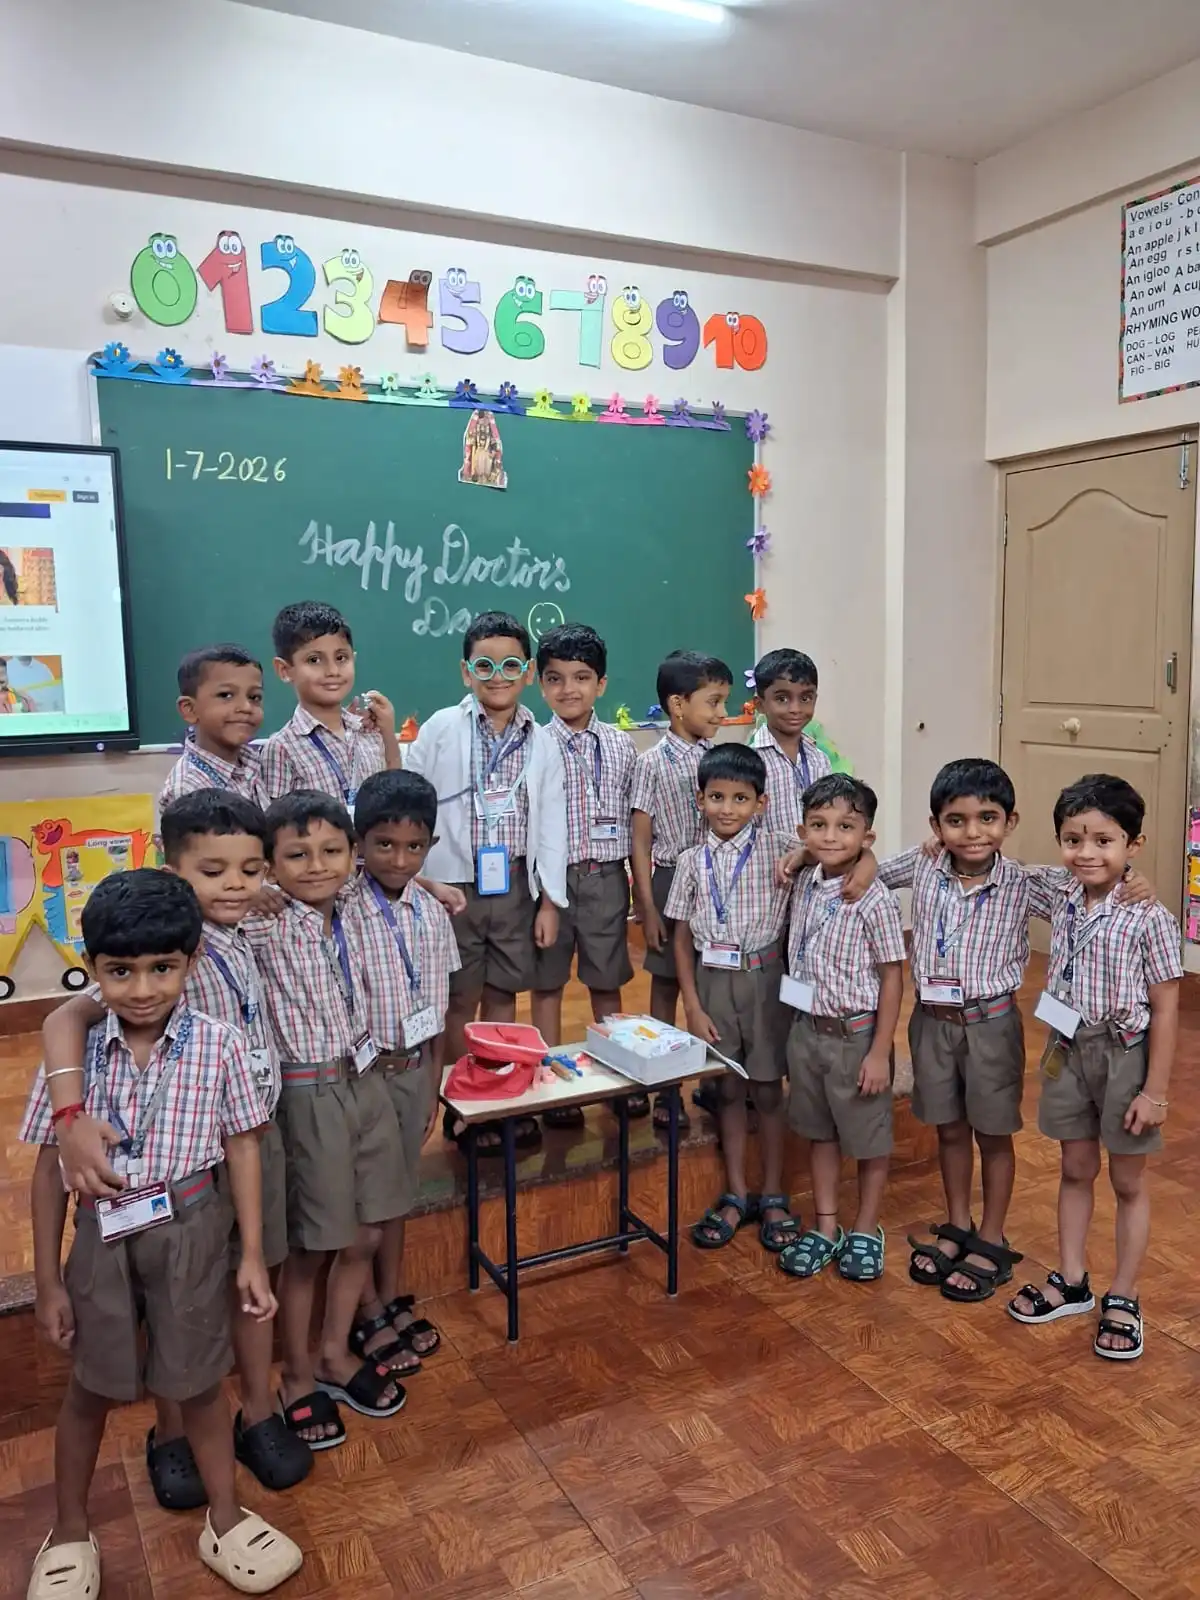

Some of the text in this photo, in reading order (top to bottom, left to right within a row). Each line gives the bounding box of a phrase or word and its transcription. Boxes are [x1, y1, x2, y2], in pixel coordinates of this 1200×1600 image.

[1178, 190, 1200, 205] Con
[1128, 229, 1135, 239] a
[1138, 226, 1145, 235] e
[1149, 222, 1153, 232] i
[1155, 221, 1162, 230] o
[1165, 217, 1172, 226] u
[1177, 227, 1181, 242] j
[1184, 225, 1191, 236] k
[1127, 233, 1174, 257] An apple
[1177, 248, 1182, 258] r
[1185, 246, 1192, 255] s
[1129, 250, 1167, 269] An egg
[1126, 265, 1170, 286] An igloo
[1175, 266, 1183, 278] A
[1130, 281, 1166, 302] An owl
[1172, 280, 1200, 295] A cu
[131, 231, 768, 371] 0 1 2 3 4 5 6 7 8 9 10
[1130, 299, 1165, 318] An urn
[1126, 305, 1200, 336] RHYMING WO
[1126, 340, 1145, 352] DOG
[1155, 331, 1176, 345] LOG
[1186, 338, 1200, 350] HU
[1126, 352, 1145, 364] CAN
[1155, 345, 1175, 357] VAN
[1130, 365, 1145, 376] FIG
[1154, 358, 1171, 371] BIG
[166, 447, 288, 483] 1-7-2026
[298, 519, 571, 603] Happy Doctor's
[412, 596, 493, 637] Da
